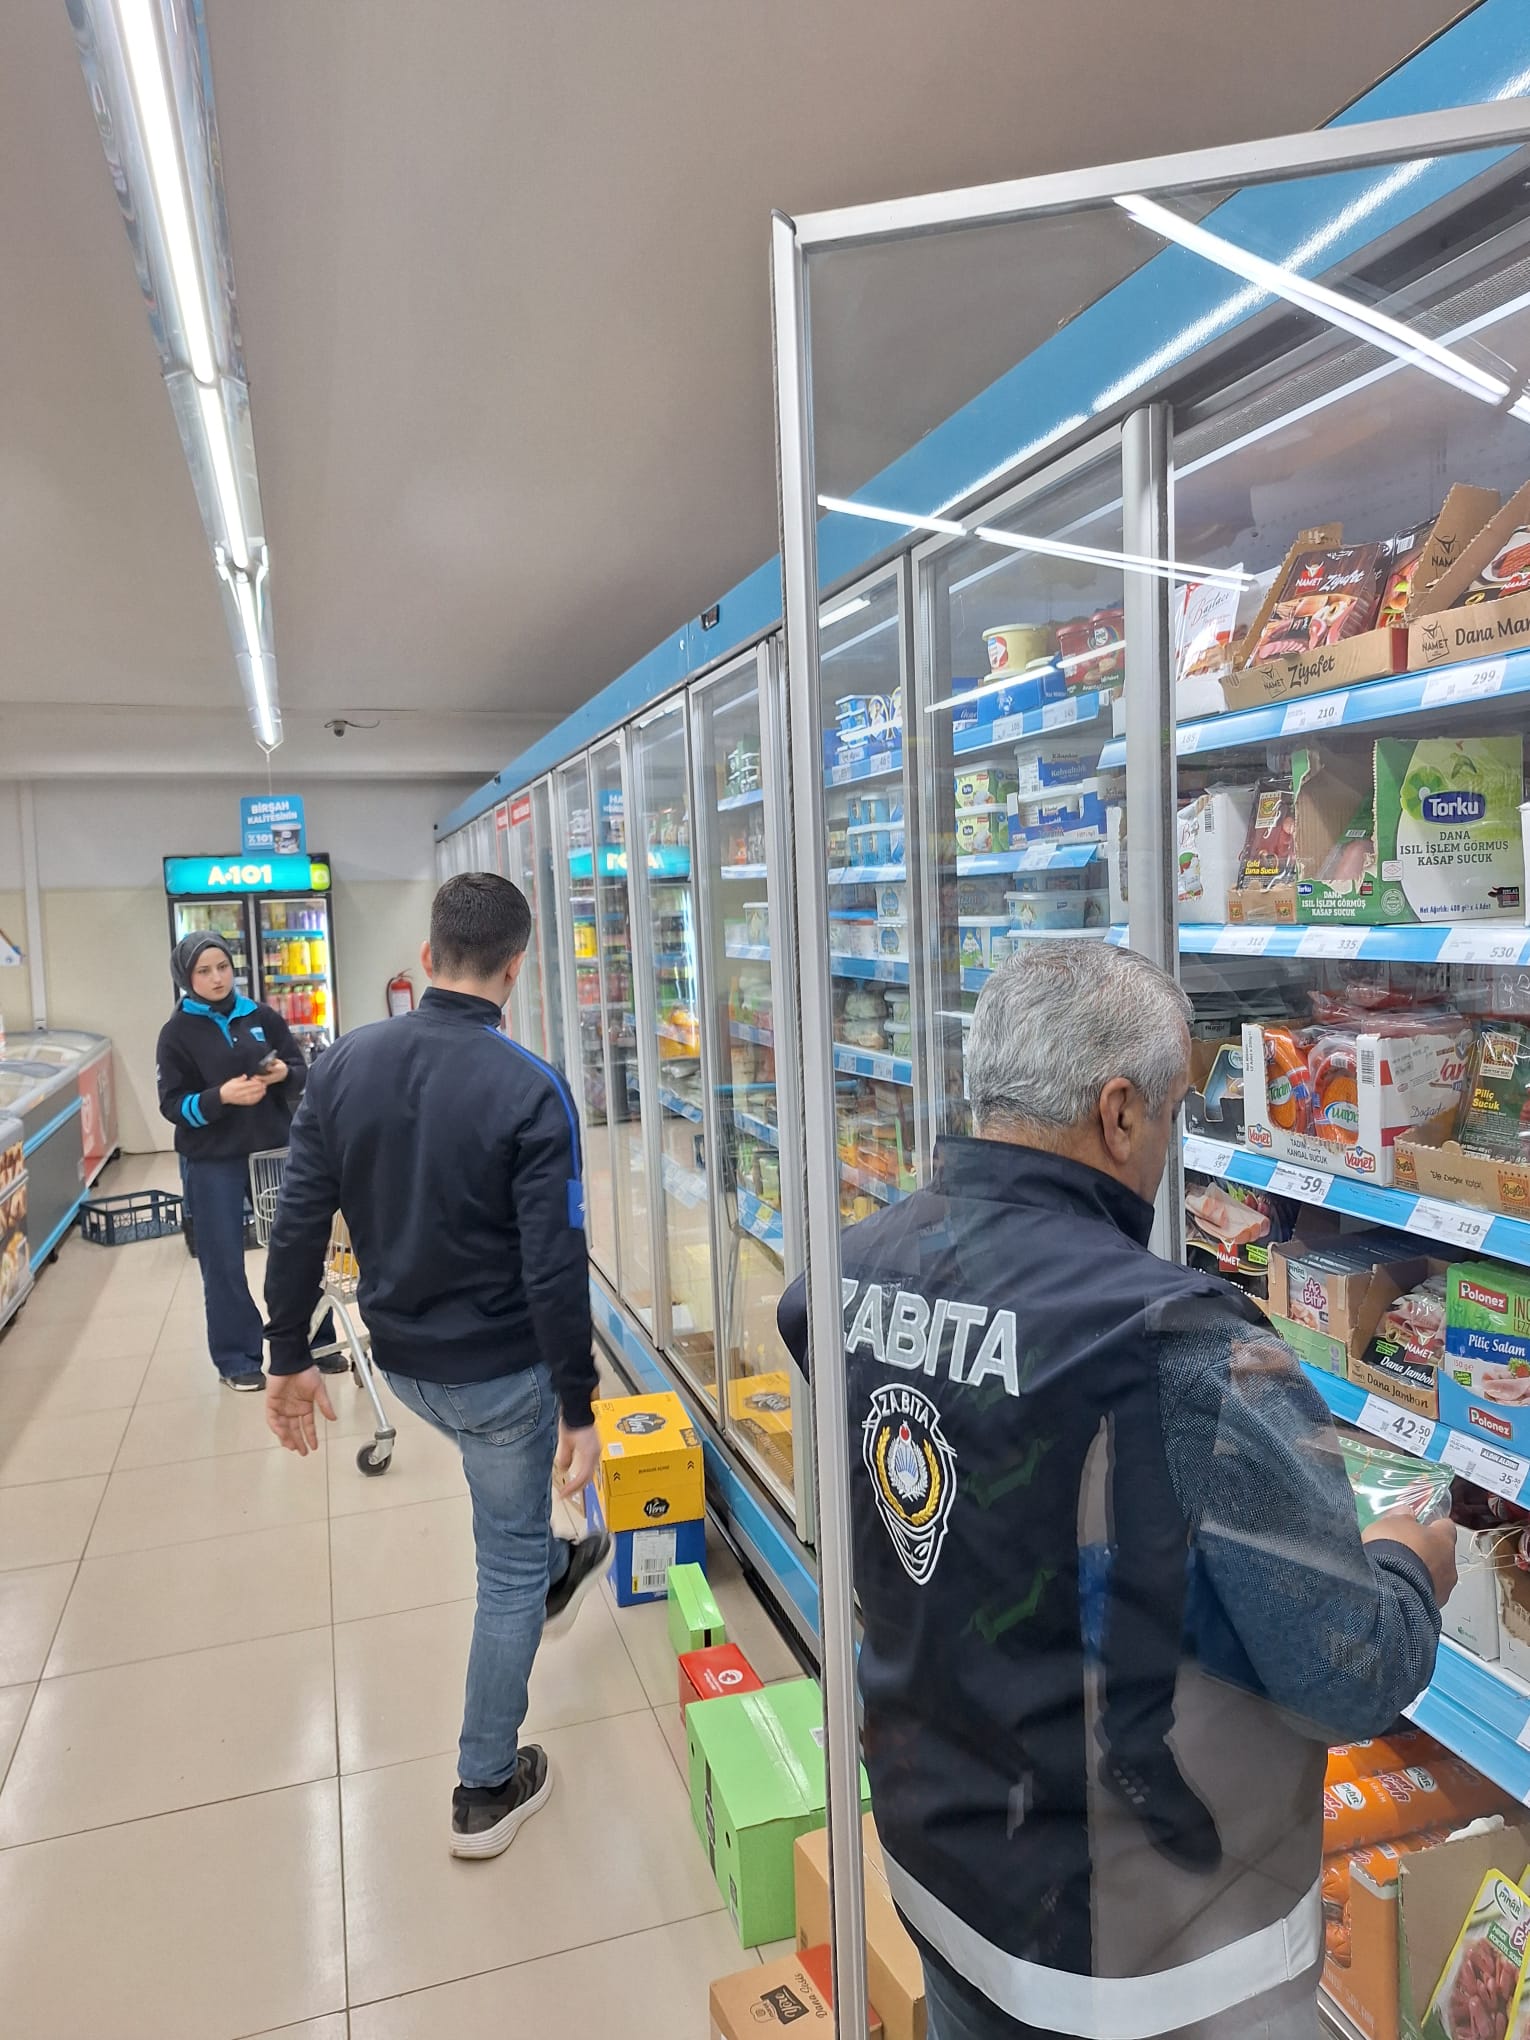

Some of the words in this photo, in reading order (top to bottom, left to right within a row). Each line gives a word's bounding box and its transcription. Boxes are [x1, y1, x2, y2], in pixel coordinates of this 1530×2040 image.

[1295, 577, 1323, 588] NAMET
[1455, 627, 1494, 646] Dana
[1422, 638, 1449, 653] NAMET
[1287, 654, 1336, 689] Ziyafet
[1471, 669, 1497, 686] 299
[1316, 706, 1335, 720] 210
[1428, 796, 1479, 817] Torku
[1439, 830, 1471, 841] DANA
[1400, 845, 1423, 855] ISIL
[1426, 841, 1460, 856] İŞLEM
[1417, 854, 1454, 866] KASAP
[1457, 853, 1493, 865] SUCUK
[1311, 908, 1332, 917] KASAP
[1333, 908, 1356, 917] SUCUK
[1489, 946, 1514, 959] 530
[1474, 1088, 1495, 1100] Piliç
[1471, 1098, 1500, 1111] Sucuk
[1249, 1128, 1271, 1145] Vanet
[1345, 1151, 1375, 1170] Vanet
[1300, 1175, 1322, 1193] 59
[1457, 1220, 1481, 1236] 119
[1216, 1250, 1241, 1267] NAMET
[1460, 1281, 1505, 1309] Polonez
[1404, 1342, 1435, 1360] NAMET
[1468, 1334, 1490, 1353] Piliç
[1491, 1338, 1526, 1357] Salam
[1380, 1355, 1404, 1374] Dana
[1402, 1365, 1436, 1386] Jambon
[1367, 1373, 1391, 1393] Dana
[1391, 1385, 1429, 1409] Jambon
[1470, 1408, 1510, 1436] Polonez
[808, 1993, 828, 2019] Dana
